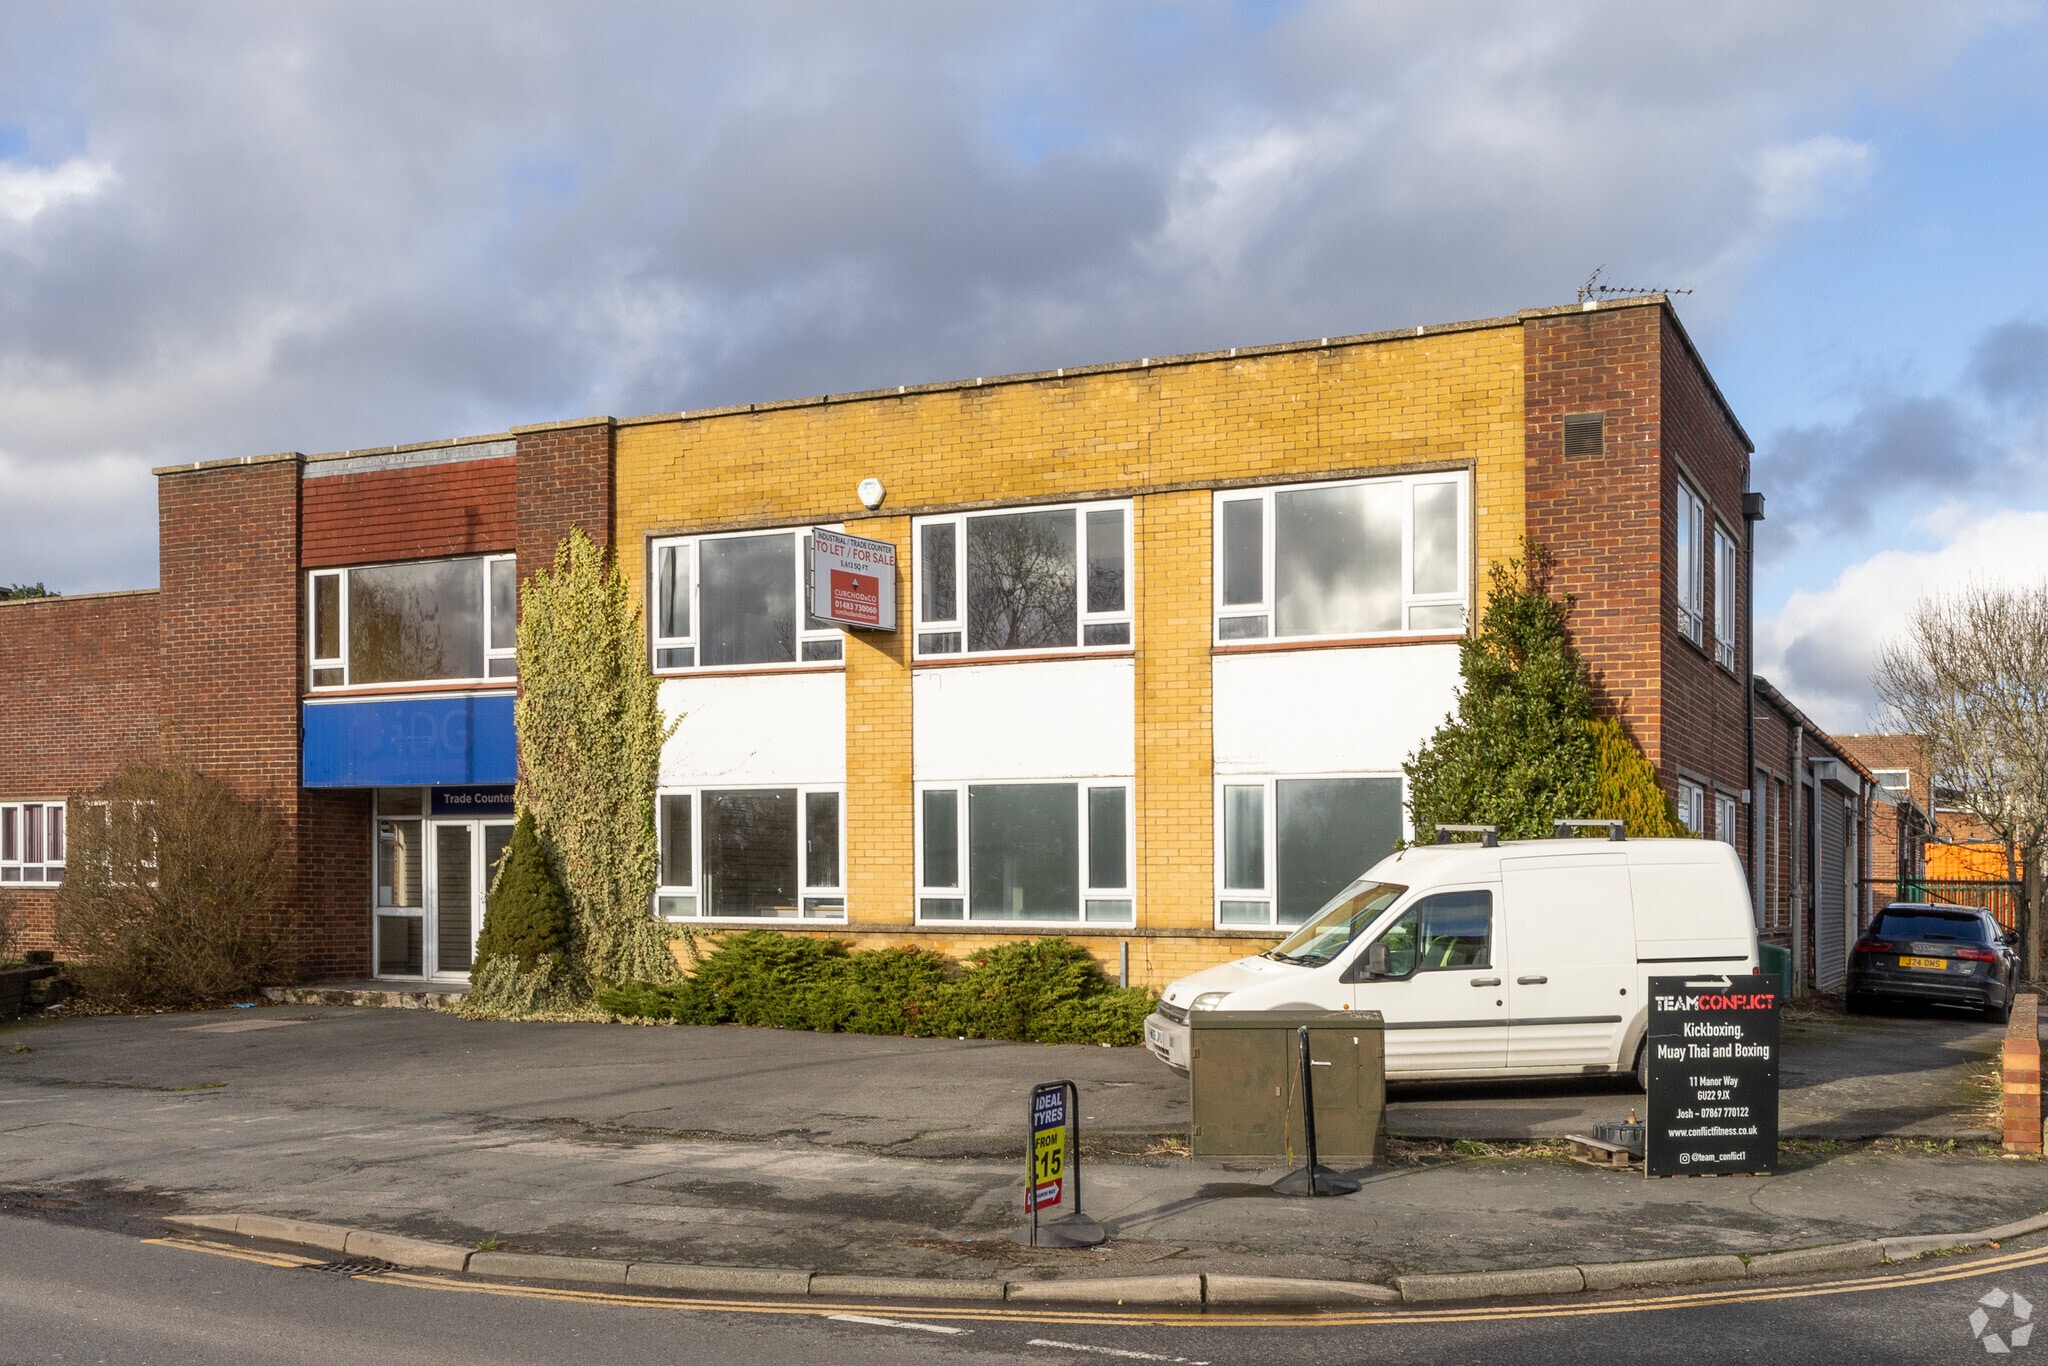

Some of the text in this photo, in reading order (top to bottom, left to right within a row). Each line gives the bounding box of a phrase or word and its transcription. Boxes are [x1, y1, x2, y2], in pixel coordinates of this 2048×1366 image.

[818, 532, 846, 545] INDUSTRIAL
[850, 540, 867, 550] TRADE
[868, 543, 892, 553] COUNTER
[816, 540, 828, 553] TO
[830, 544, 845, 557] LET
[853, 548, 871, 562] FOR
[872, 551, 895, 566] SALE
[840, 560, 869, 571] 5,613 SQ FT
[835, 600, 877, 614] 01483 730060
[835, 608, 877, 620] curchodandco.com
[444, 793, 515, 804] Trade Counter
[1905, 958, 1921, 966] J24
[1657, 1042, 1770, 1062] Muay Thai and Boxing
[1689, 1075, 1739, 1088] 11 Manor Way
[1036, 1092, 1062, 1110] IDEAL
[1697, 1089, 1731, 1101] GU22 9JX
[1034, 1107, 1063, 1126] TYRES
[1676, 1108, 1694, 1119] Josh
[1701, 1107, 1722, 1118] 07867
[1723, 1106, 1750, 1118] 770122
[1668, 1125, 1758, 1137] www.conflictfitness.co.uk
[1035, 1133, 1058, 1149] FROM
[1691, 1151, 1746, 1162] @team_conflict1
